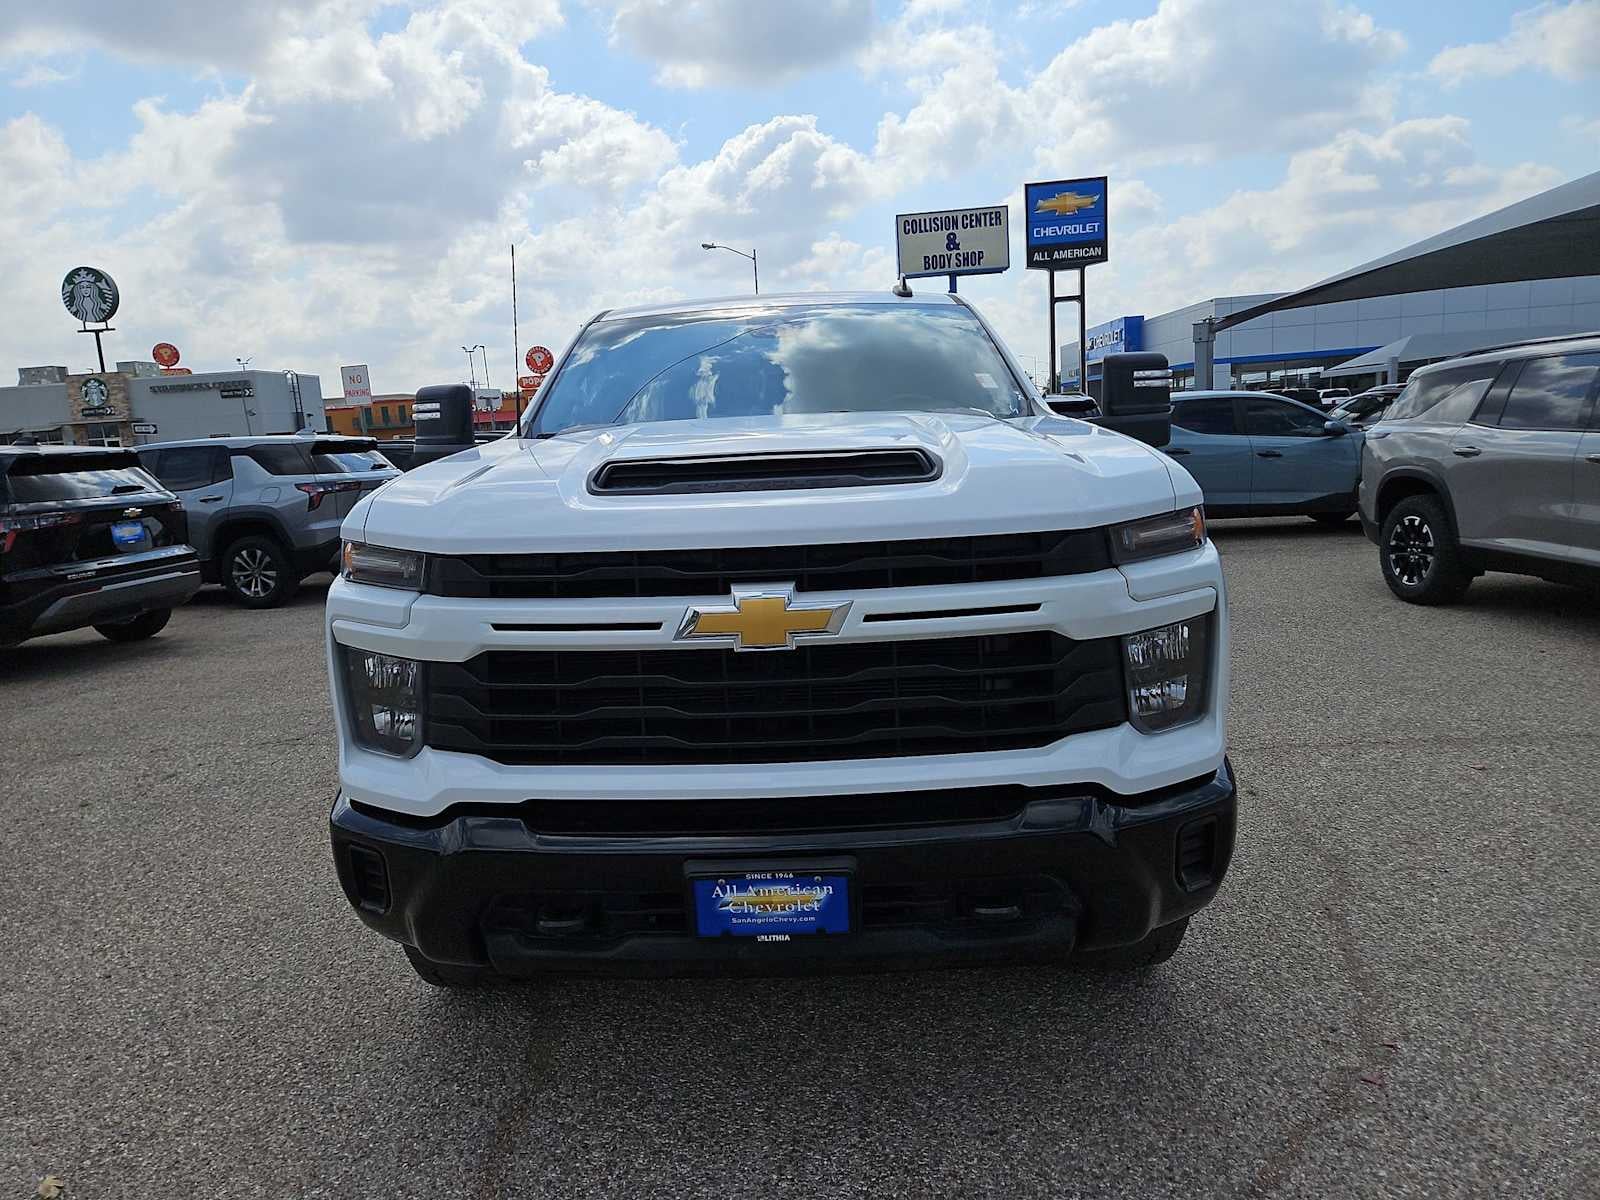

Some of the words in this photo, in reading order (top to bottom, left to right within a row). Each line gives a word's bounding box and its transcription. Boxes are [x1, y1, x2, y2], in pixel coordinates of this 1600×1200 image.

[903, 214, 959, 235] COLLISION
[961, 211, 1002, 229] CENTER
[1033, 222, 1100, 238] CHEVROLET
[945, 232, 961, 252] &
[923, 253, 953, 271] BODY
[955, 250, 984, 268] SHOP
[1033, 251, 1050, 262] ALL
[1053, 246, 1102, 260] AMERICAN
[349, 375, 362, 384] NO
[345, 388, 369, 397] PARKING
[711, 884, 737, 899] All
[746, 883, 833, 897] American
[728, 898, 821, 914] Chevrolet
[731, 916, 816, 925] SanAngeloChevy.com
[764, 934, 791, 942] LITHIA
